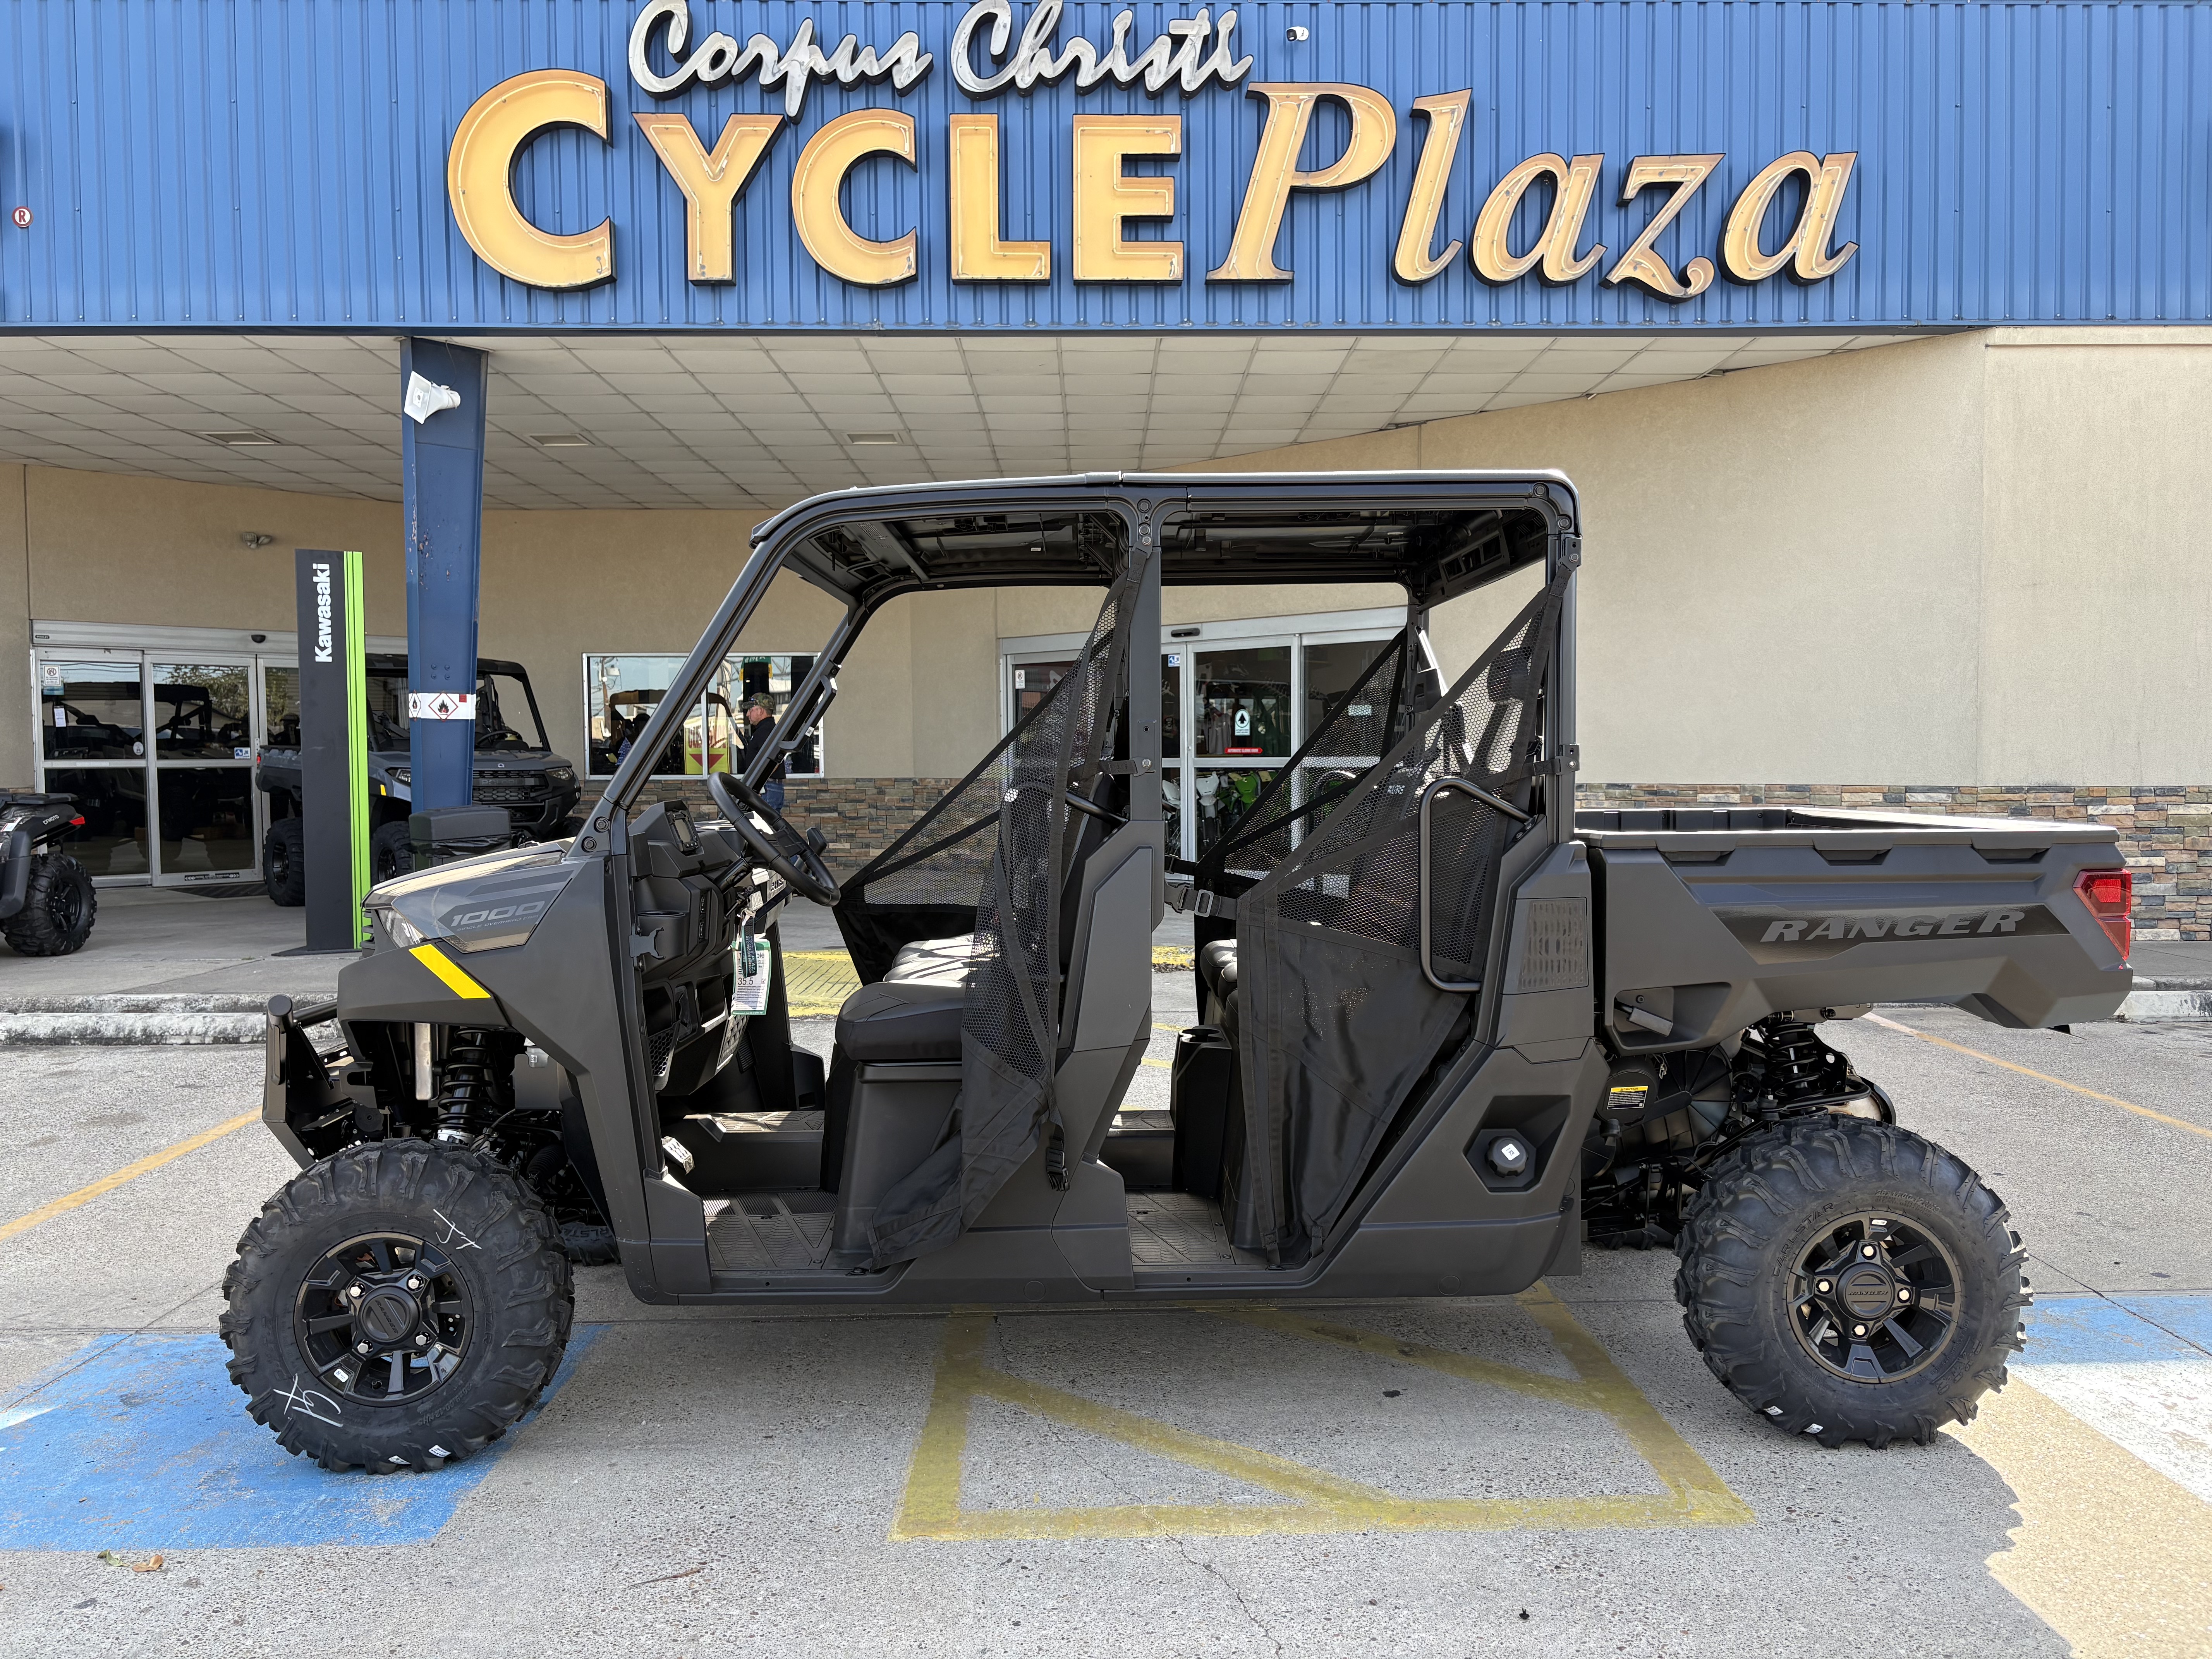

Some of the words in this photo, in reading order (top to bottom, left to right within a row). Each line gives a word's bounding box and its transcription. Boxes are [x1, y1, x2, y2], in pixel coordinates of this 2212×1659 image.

[628, 0, 934, 125] Corpus
[950, 0, 1254, 100] Christi
[447, 68, 1183, 292] CYCLE
[1205, 81, 1860, 304] Plaza
[313, 563, 332, 662] Kawasaki
[43, 814, 59, 825] CFMOTO
[450, 901, 545, 927] 1000
[1759, 910, 2025, 943] RANGER
[738, 977, 754, 985] 35.5
[375, 1300, 398, 1334] RANGER
